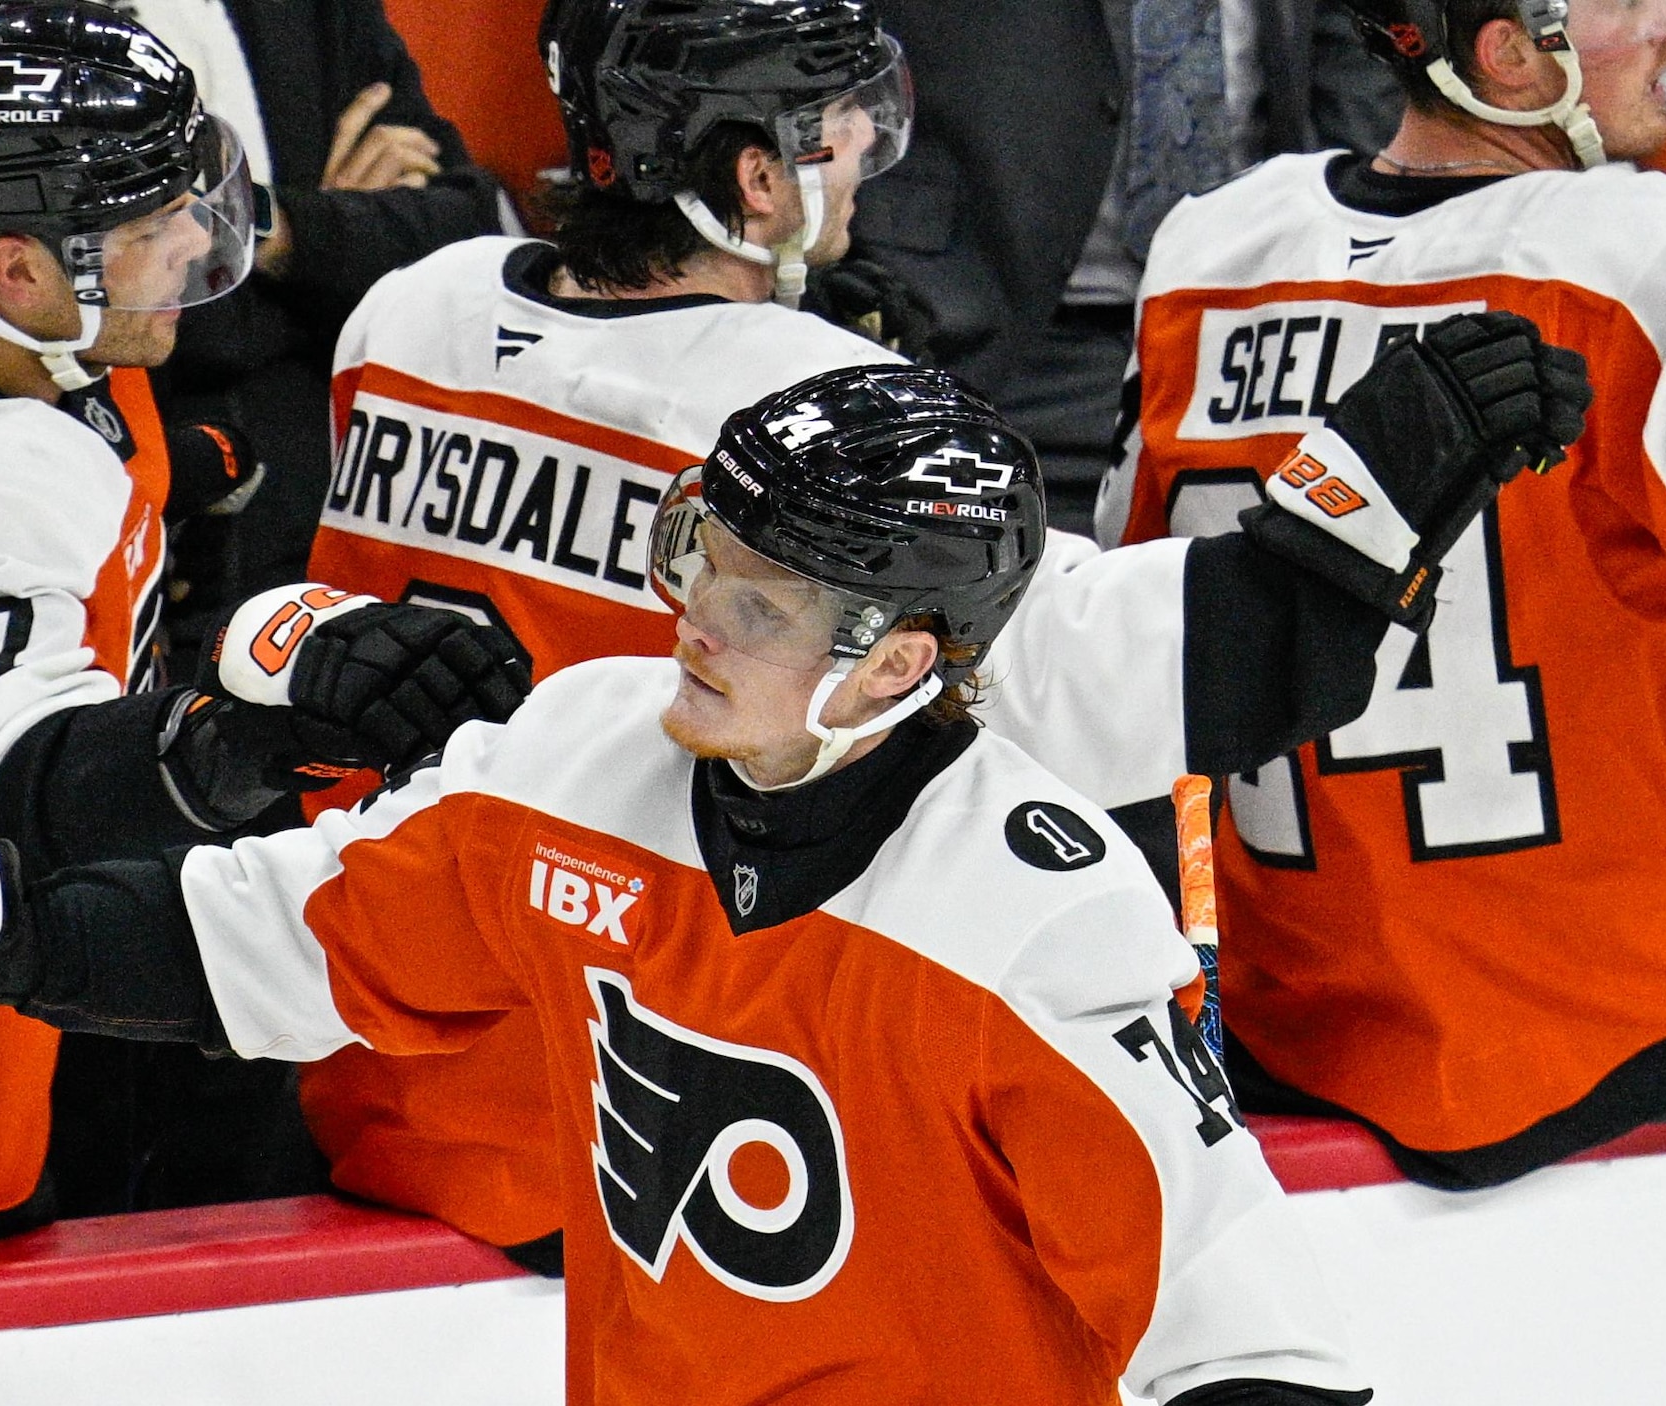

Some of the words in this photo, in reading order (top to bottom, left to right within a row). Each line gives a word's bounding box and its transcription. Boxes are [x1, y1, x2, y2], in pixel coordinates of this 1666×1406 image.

[1208, 315, 1441, 424] SEEL
[763, 401, 835, 451] 74
[327, 408, 663, 592] DRYSDALE
[715, 449, 765, 498] BAUER
[906, 500, 1007, 522] CHEVROLET
[535, 841, 627, 887] Independence
[1025, 808, 1092, 864] 1
[529, 858, 639, 946] IBX
[1111, 994, 1247, 1148] 74
